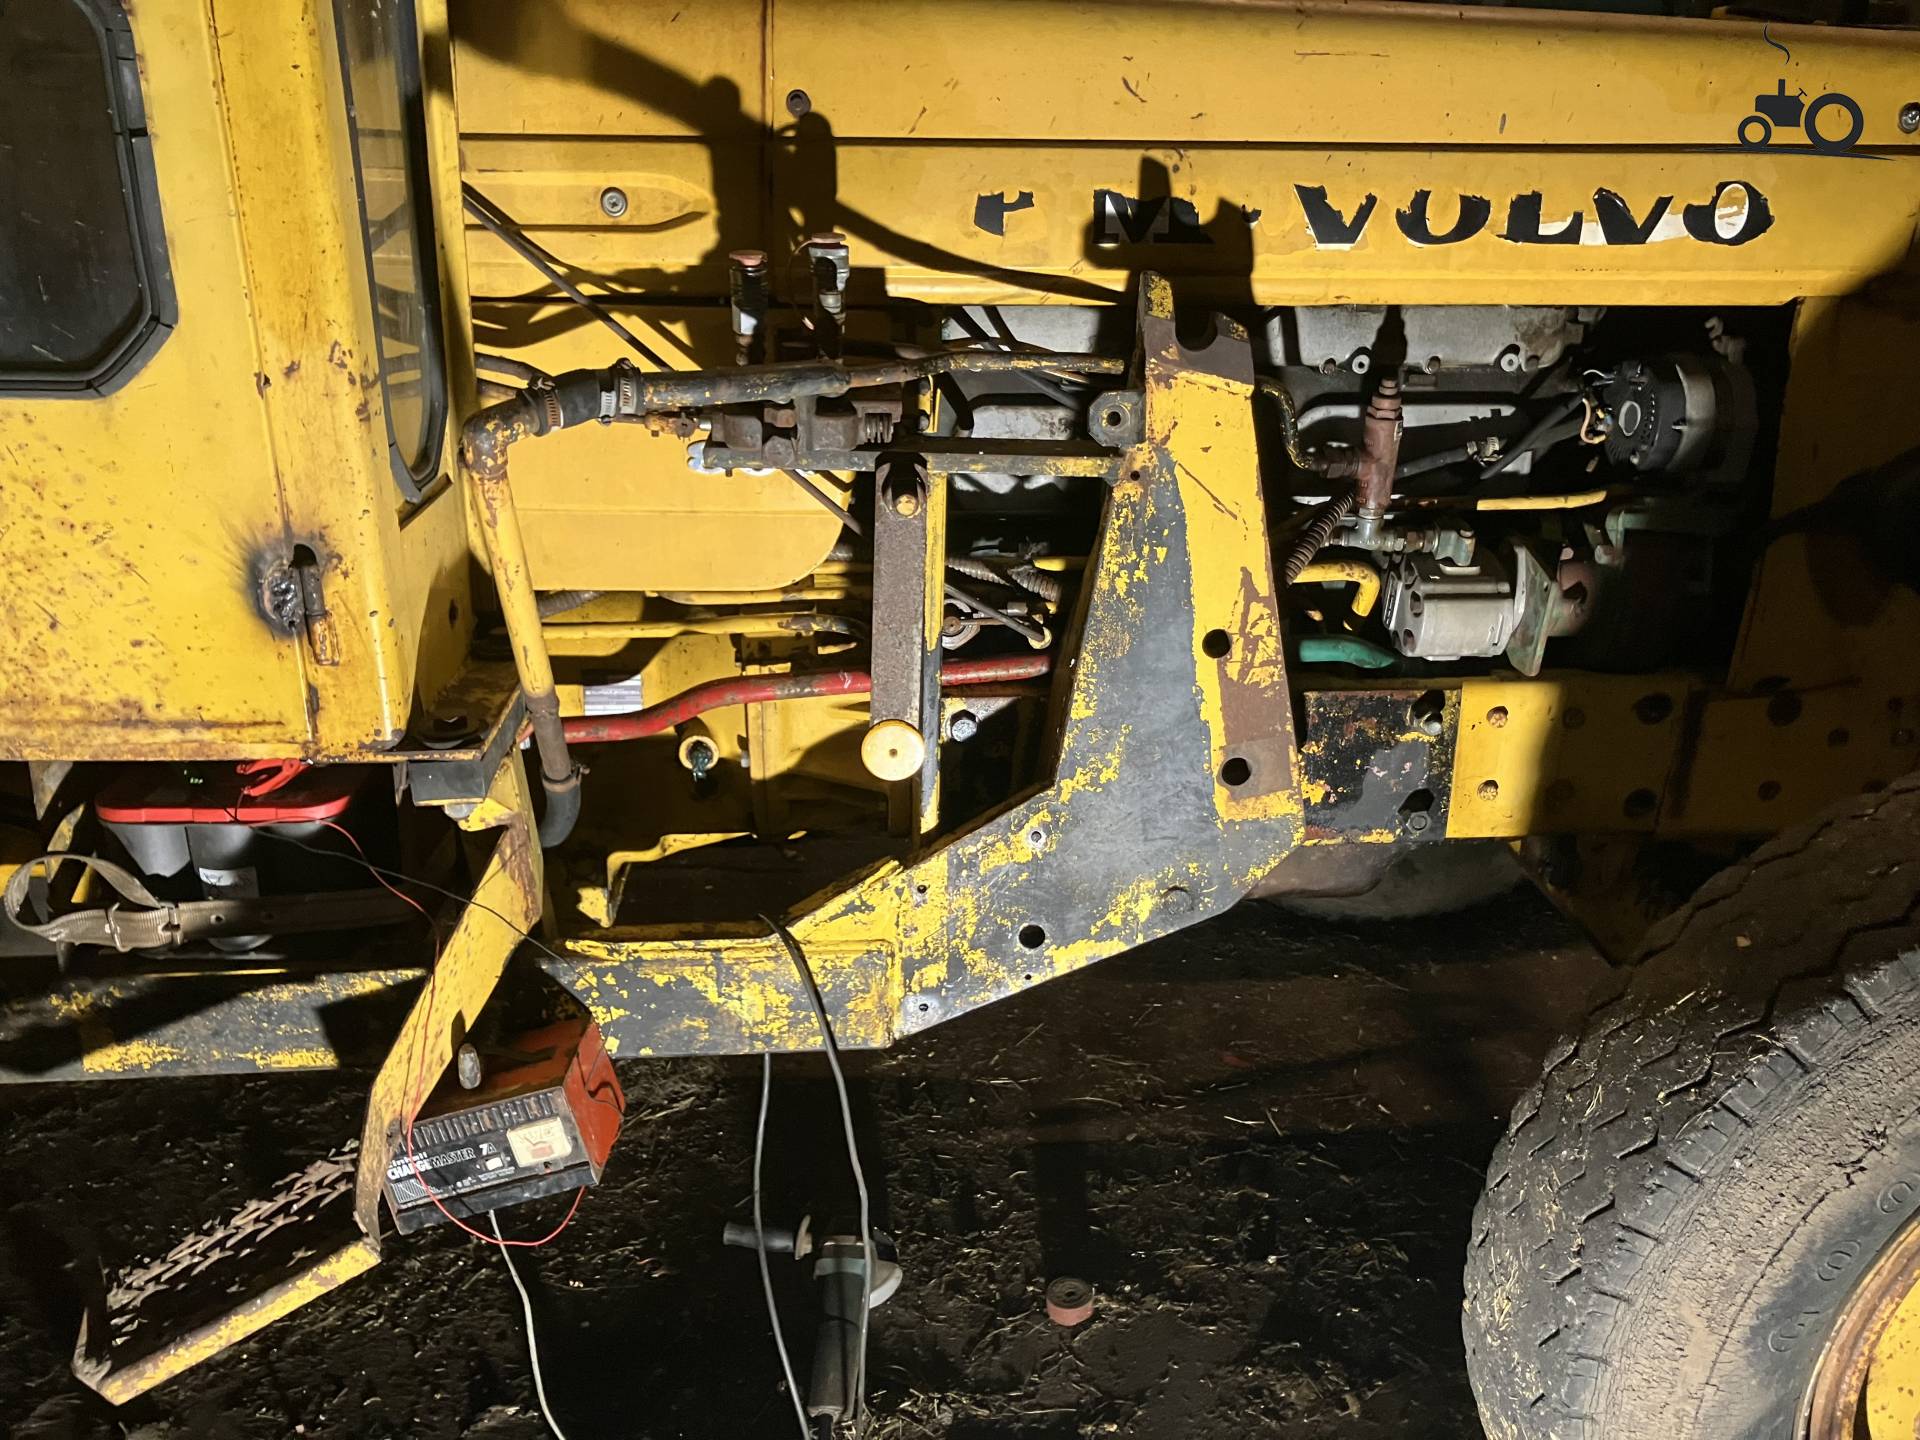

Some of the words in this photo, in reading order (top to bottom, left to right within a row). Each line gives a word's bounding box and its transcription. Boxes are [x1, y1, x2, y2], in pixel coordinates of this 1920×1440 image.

[1293, 180, 1775, 247] VOLVO
[479, 1142, 497, 1156] 7A
[388, 1151, 428, 1169] inhell
